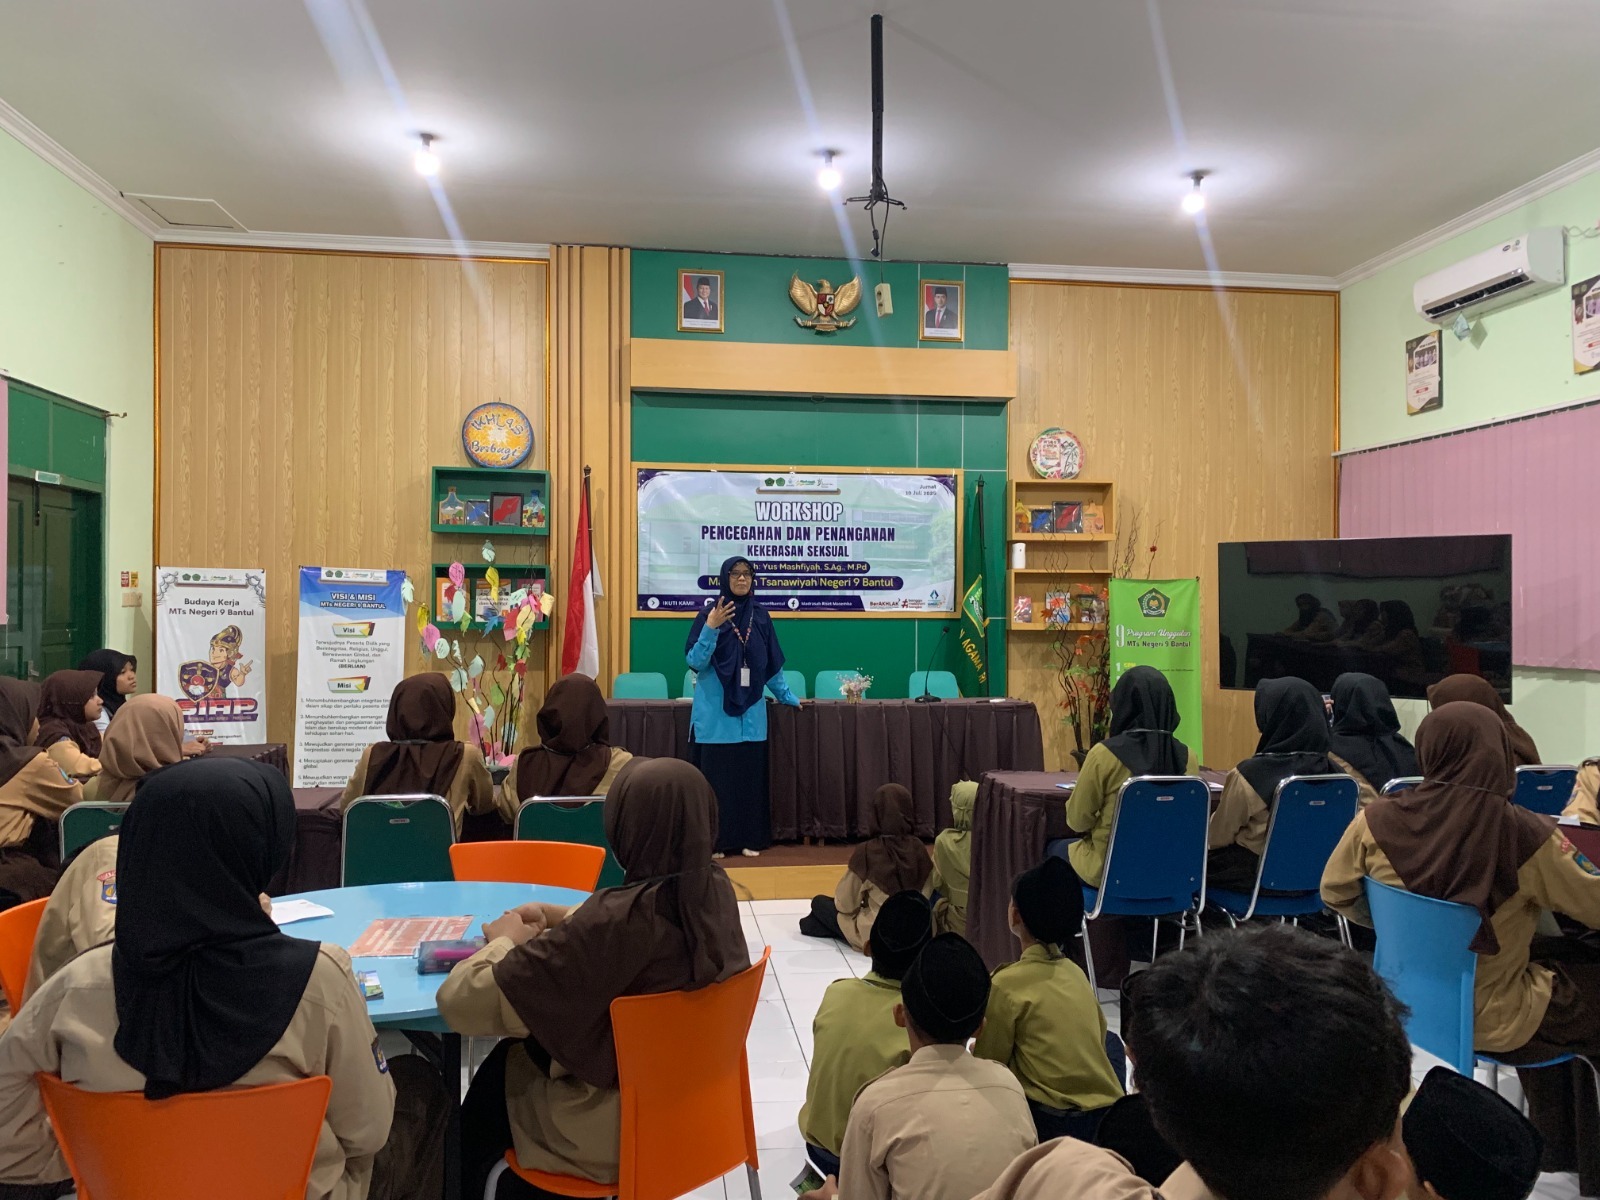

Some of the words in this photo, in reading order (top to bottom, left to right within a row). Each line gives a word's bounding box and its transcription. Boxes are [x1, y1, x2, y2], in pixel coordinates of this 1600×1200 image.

[755, 501, 843, 521] WORKSHOP
[701, 525, 781, 541] PENCEGAHAN
[787, 526, 810, 541] DAN
[816, 527, 895, 542] PENANGANAN
[747, 544, 803, 557] KEKERASAN
[807, 545, 849, 557] SEKSUAL
[762, 563, 777, 571] Yus
[847, 563, 868, 571] M.Pd
[760, 577, 818, 589] Tsanawiyah
[820, 577, 850, 589] Negeri
[853, 578, 859, 587] 9
[862, 578, 894, 587] Bantul
[184, 598, 215, 607] Budaya
[218, 598, 240, 607] Kerja
[331, 592, 347, 600] VISI
[358, 593, 376, 601] MISI
[189, 608, 218, 617] Negeri
[1116, 624, 1125, 648] 9
[1127, 628, 1156, 639] Program
[1157, 628, 1191, 639] Unggulan
[1142, 640, 1163, 648] Negeri
[961, 638, 983, 672] AGAMA
[177, 698, 257, 716] SIAP
